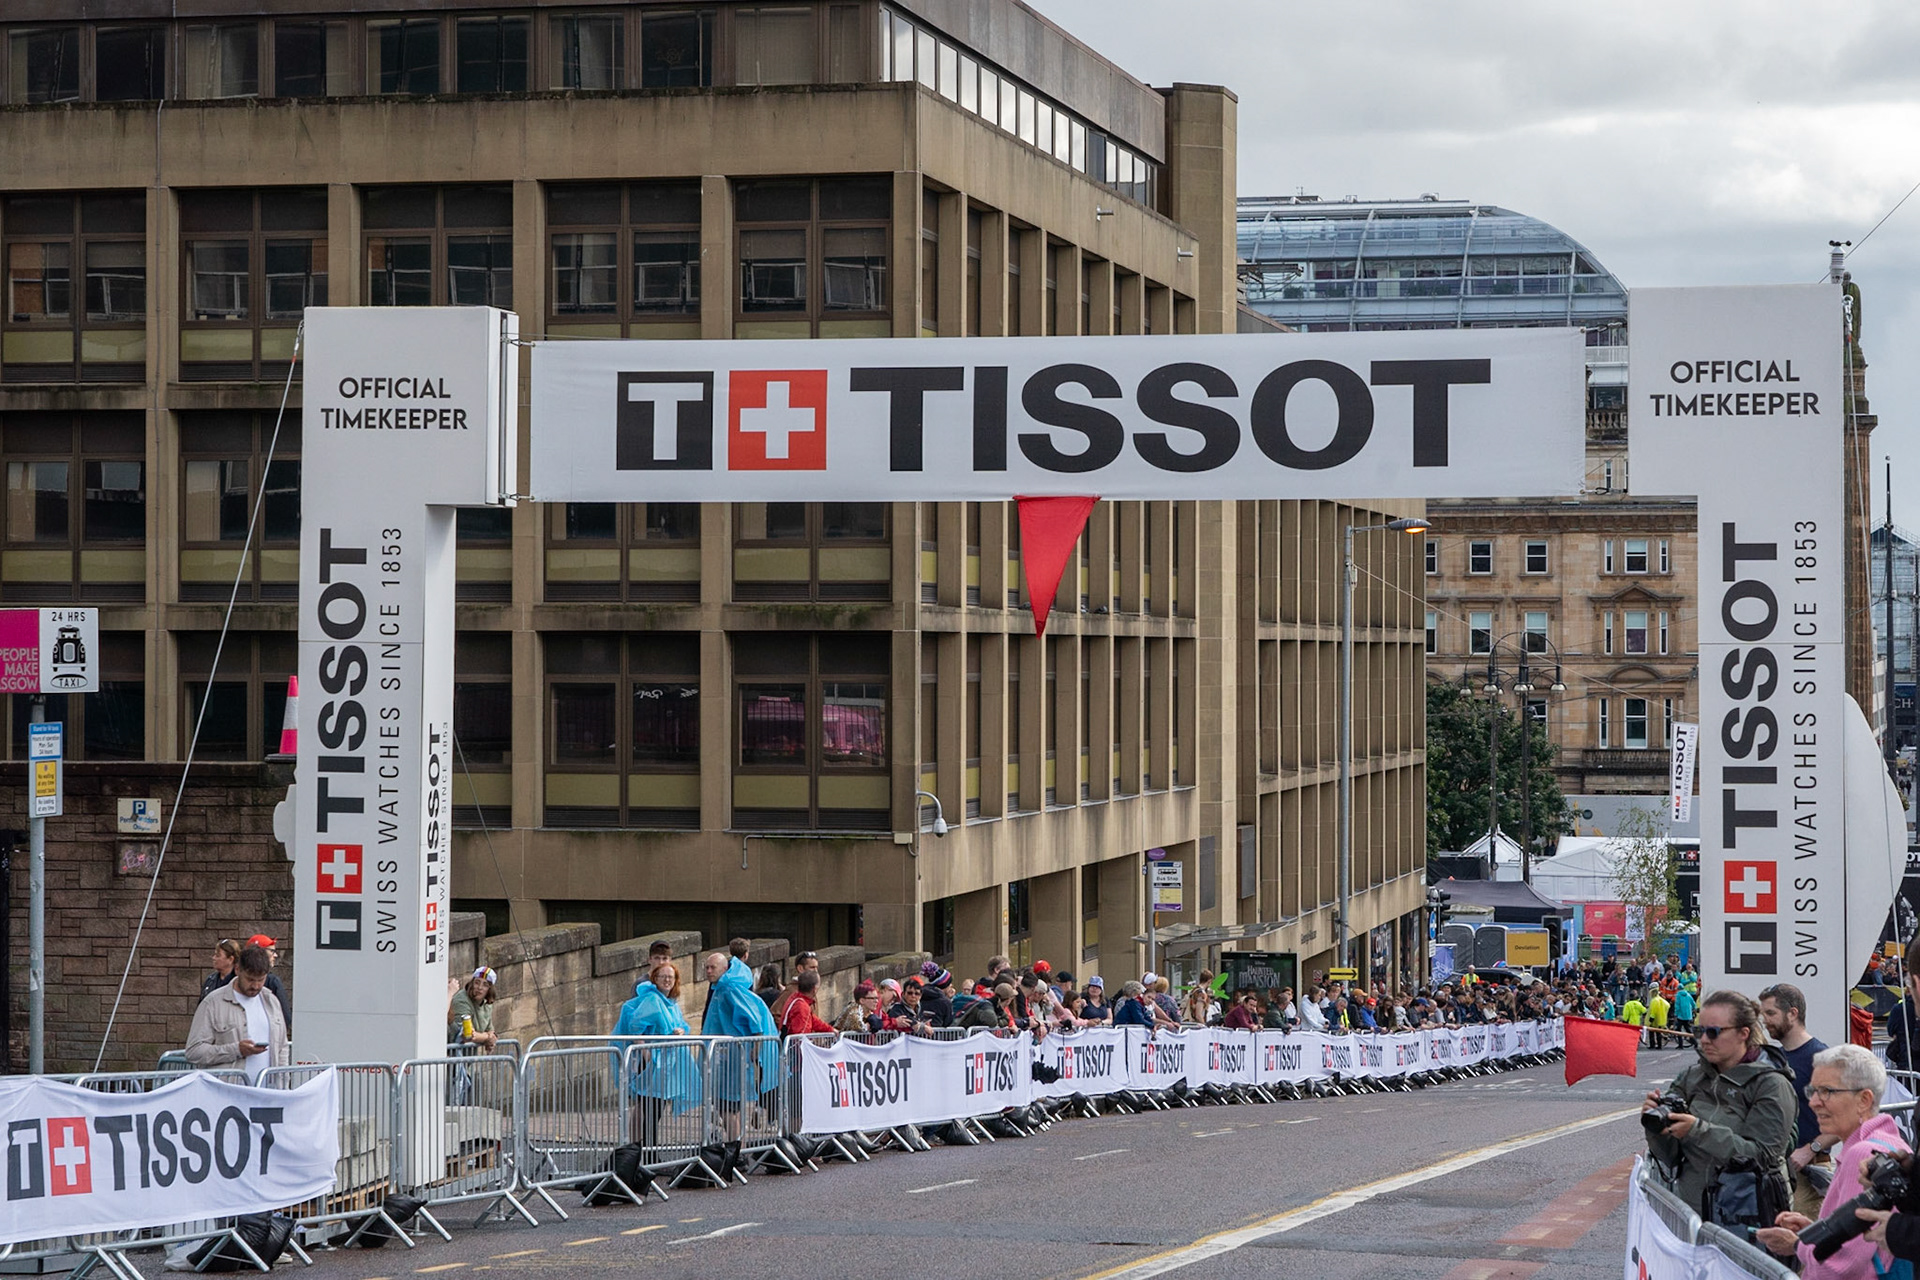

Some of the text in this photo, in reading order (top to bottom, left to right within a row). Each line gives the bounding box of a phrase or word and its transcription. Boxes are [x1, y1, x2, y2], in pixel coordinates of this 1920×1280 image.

[1669, 359, 1801, 384] OFFICIAL
[338, 376, 452, 399] OFFICIAL
[320, 408, 468, 430] TIMEKEEPER
[849, 358, 1492, 474] TISSOT
[1649, 392, 1821, 417] TIMEKEEPER
[52, 611, 86, 622] 24 HRS
[5, 662, 38, 676] MAKE
[59, 678, 80, 687] TAXI
[316, 527, 368, 834] TISSOT
[1721, 522, 1779, 849] TISSOT
[376, 527, 402, 953] SWISS WATCHES SINCE 1853
[1793, 520, 1818, 977] SWISS WATCHES SINCE 1853
[1675, 725, 1688, 790] TISSOT
[426, 722, 441, 898] TISSOT
[1239, 970, 1281, 988] MANSION
[1247, 965, 1275, 976] HAUNTED
[1073, 1043, 1115, 1079] TISSOT
[1155, 1043, 1186, 1074] TISSOT
[1219, 1043, 1246, 1073] TISSOT
[1275, 1044, 1302, 1071] TISSOT
[845, 1057, 912, 1107] TISSOT
[94, 1106, 284, 1192] TISSOT
